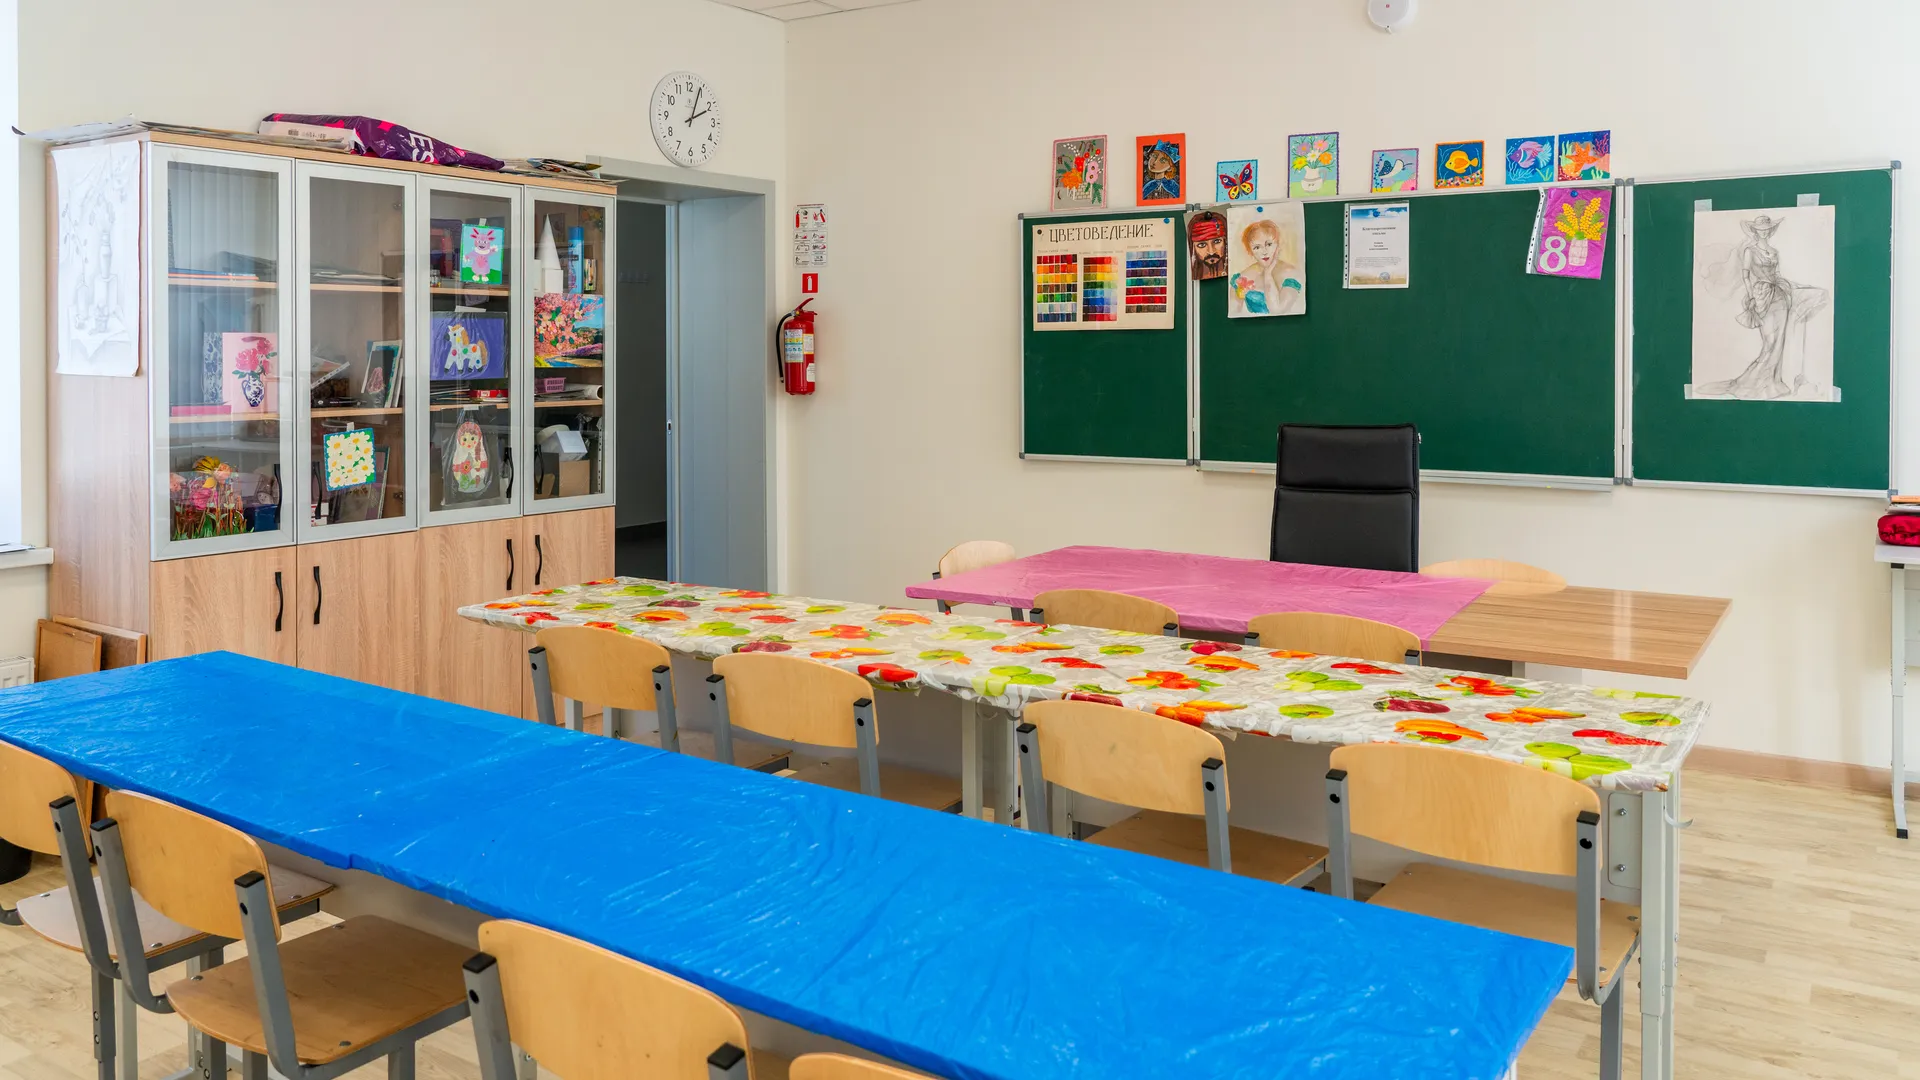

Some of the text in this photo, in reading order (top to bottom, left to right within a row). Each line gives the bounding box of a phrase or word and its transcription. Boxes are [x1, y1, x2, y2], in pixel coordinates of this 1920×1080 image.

[675, 83, 682, 95] 11
[685, 81, 693, 92] 12
[667, 95, 675, 106] 10
[706, 101, 712, 112] 2
[663, 110, 669, 120] 9
[710, 117, 716, 128] 3
[667, 126, 673, 137] 8
[707, 132, 713, 142] 4
[676, 140, 681, 150] 7
[701, 143, 706, 154] 5
[688, 146, 693, 157] 6
[1049, 223, 1154, 243] ЦВЕТОВЕДЕНИЕ
[1540, 236, 1567, 272] 8
